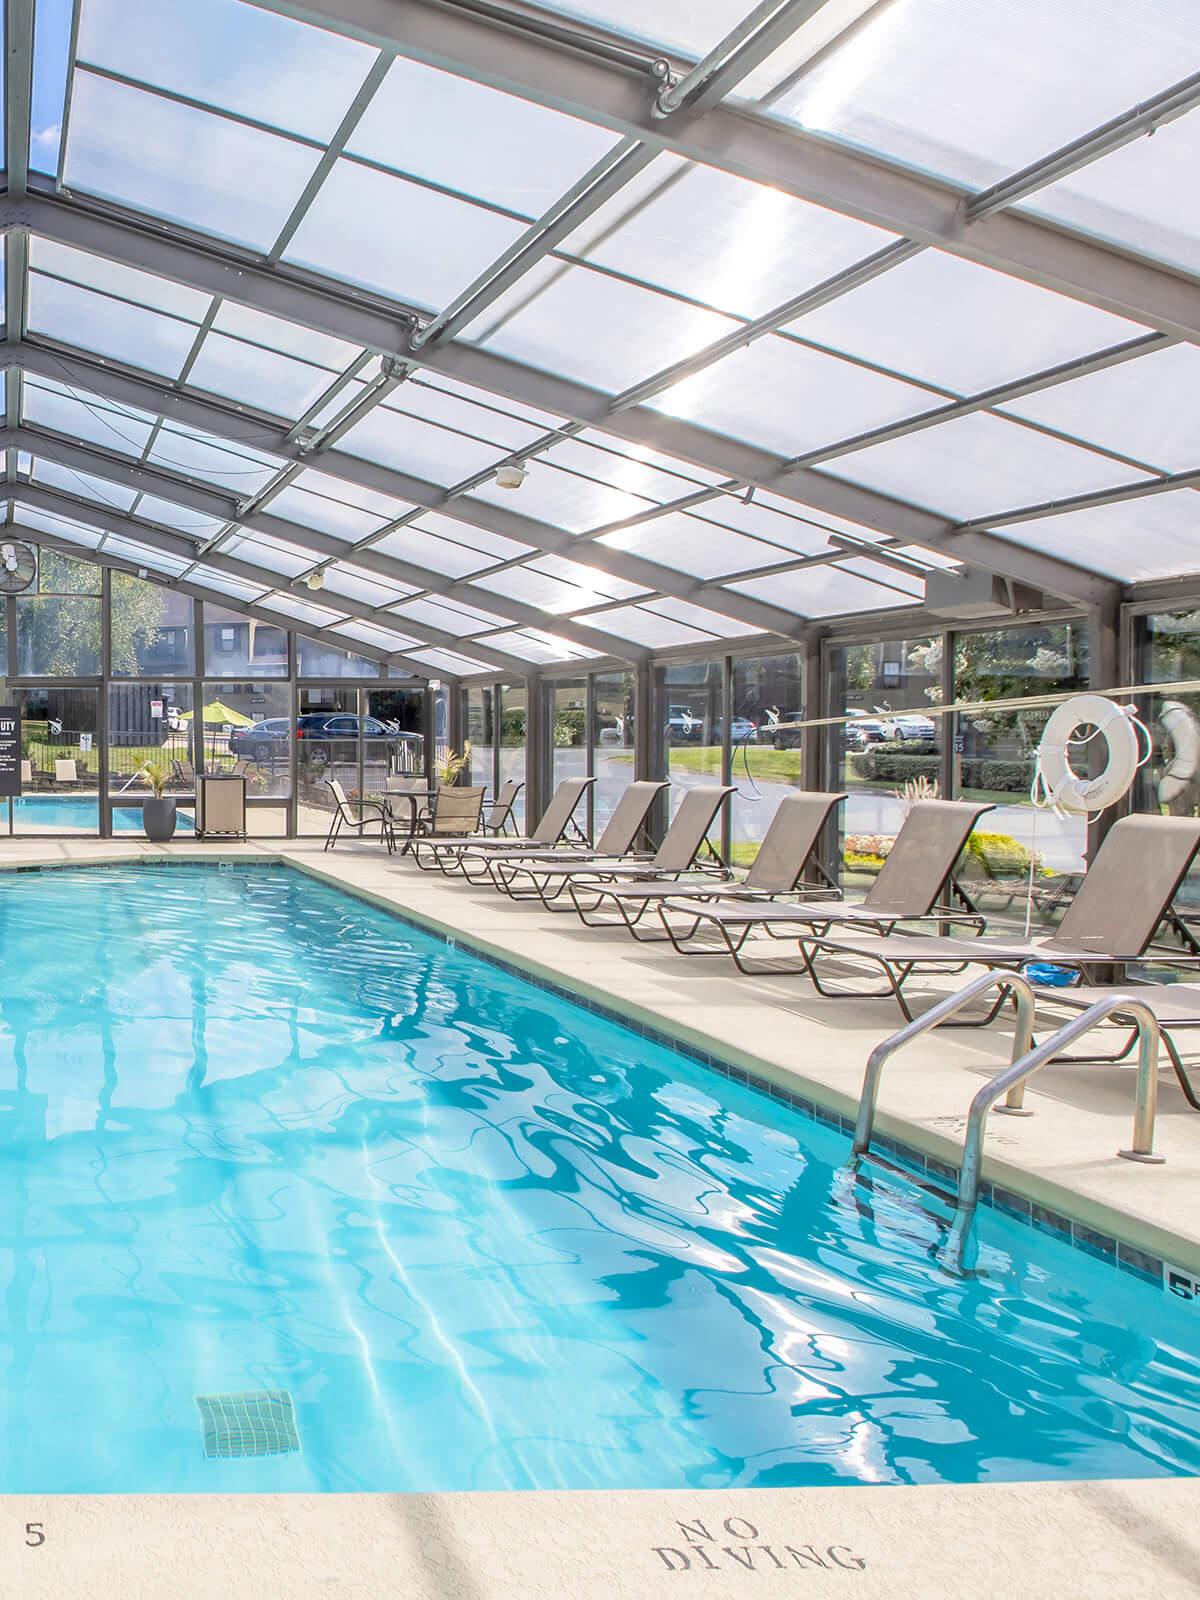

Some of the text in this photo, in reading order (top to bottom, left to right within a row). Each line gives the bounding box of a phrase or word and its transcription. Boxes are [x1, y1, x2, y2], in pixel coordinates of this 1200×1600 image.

[1169, 1272, 1193, 1300] 5
[25, 1522, 45, 1547] 5
[676, 1516, 759, 1542] NO
[651, 1545, 866, 1571] DIVING
